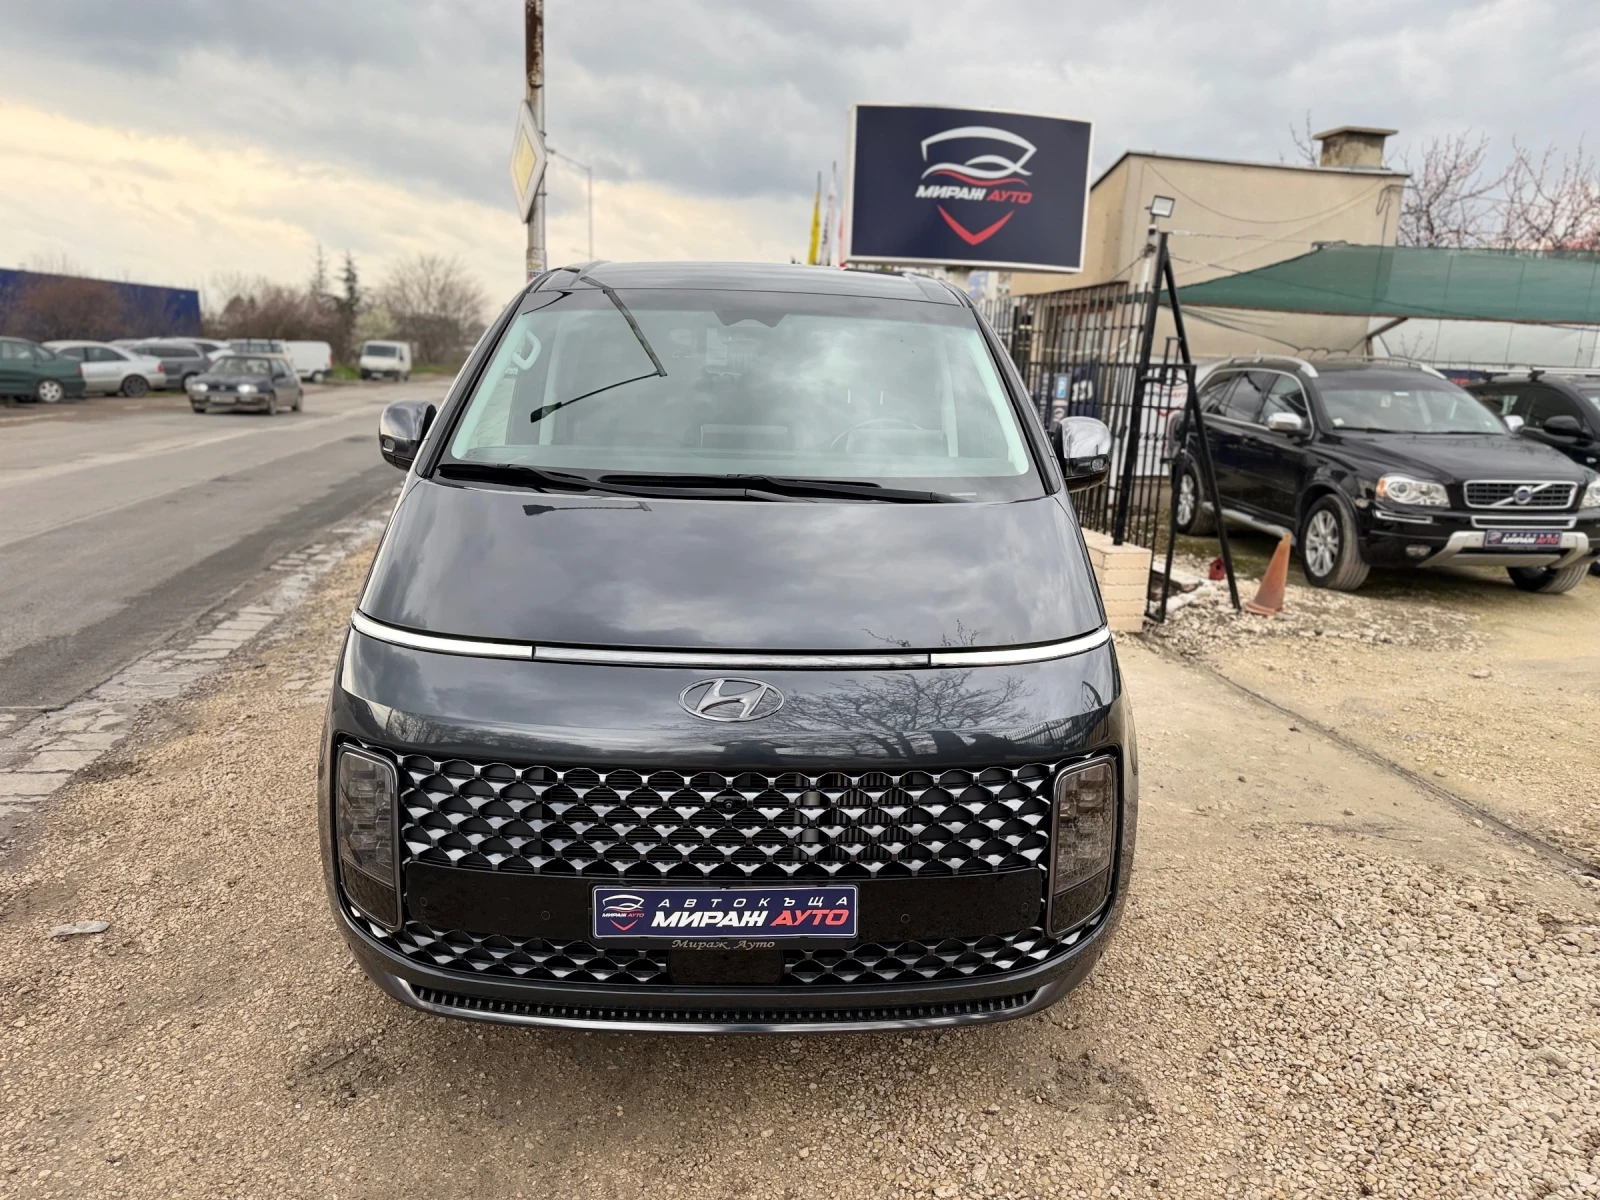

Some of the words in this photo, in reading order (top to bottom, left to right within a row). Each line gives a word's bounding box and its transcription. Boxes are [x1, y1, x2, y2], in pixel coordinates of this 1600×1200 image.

[915, 185, 987, 201] МИРАЖ
[986, 189, 1033, 204] АУТО
[658, 896, 848, 908] АВТОКЪЩА
[651, 910, 769, 928] МИРАЖ
[770, 909, 849, 926] АУТО
[671, 939, 731, 950] Мираж
[733, 939, 776, 950] Ауто
